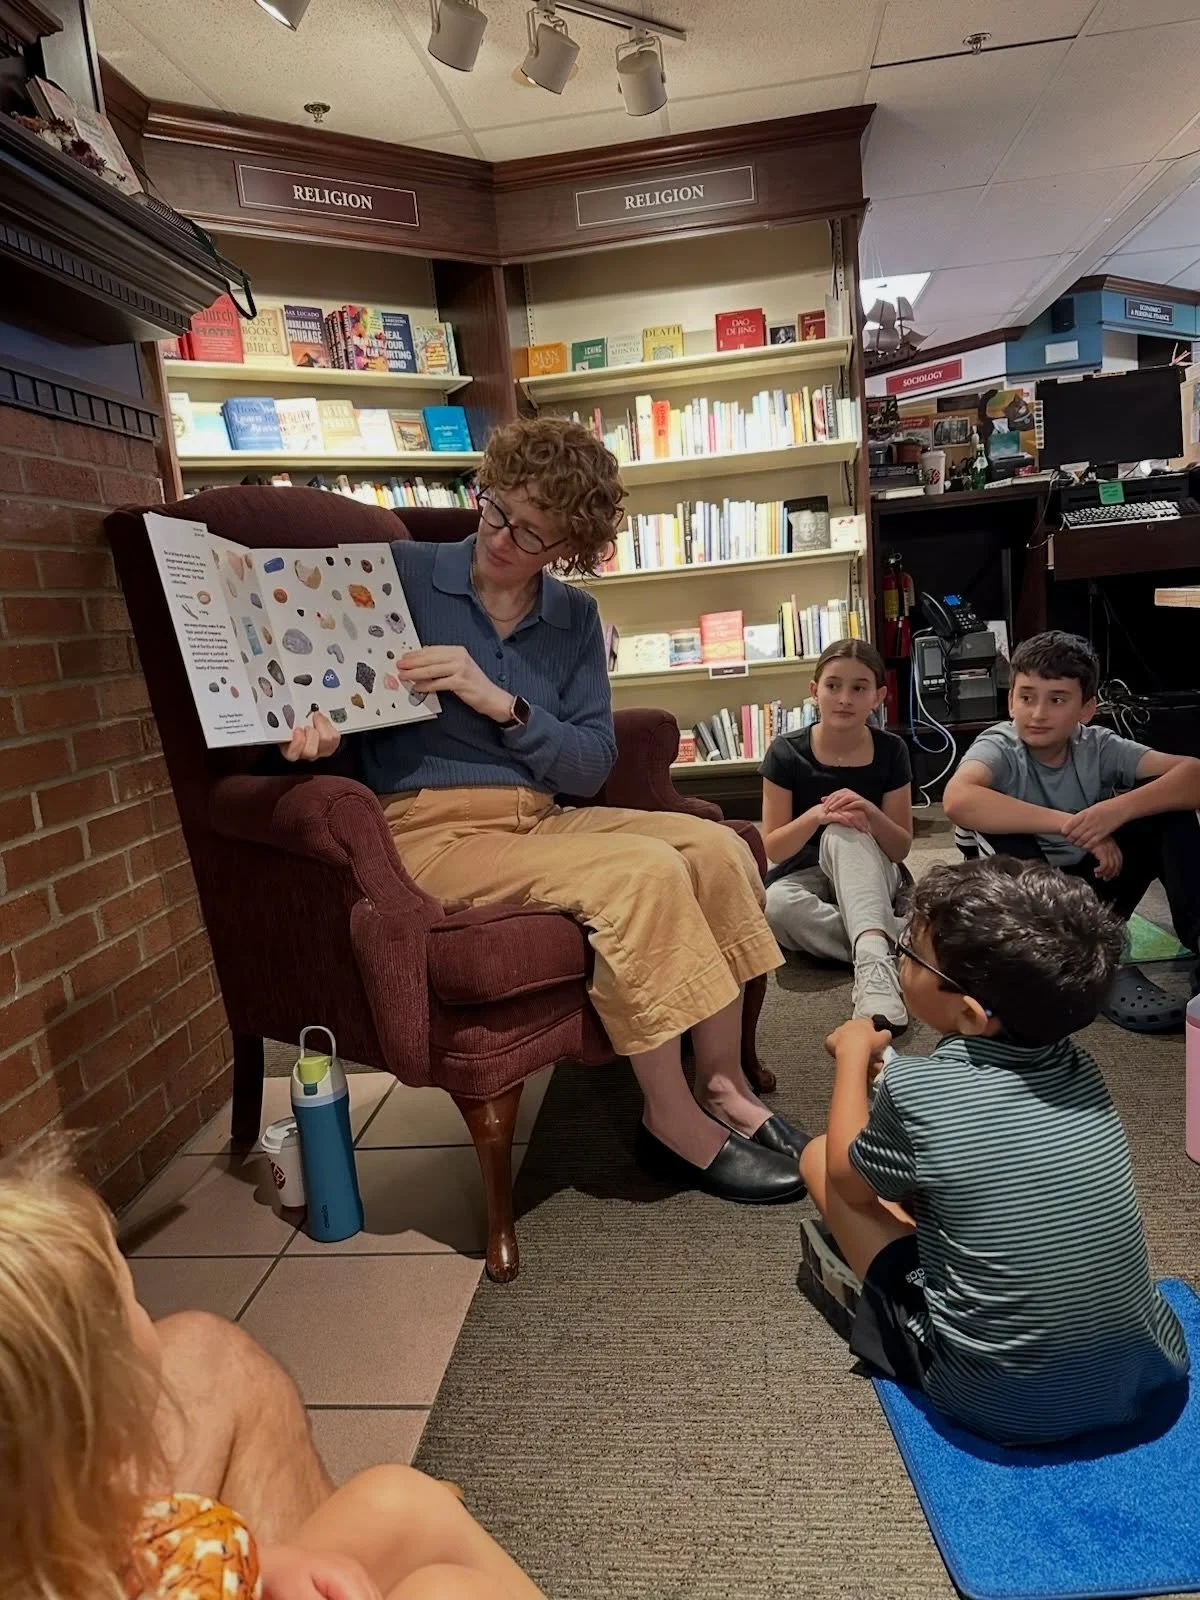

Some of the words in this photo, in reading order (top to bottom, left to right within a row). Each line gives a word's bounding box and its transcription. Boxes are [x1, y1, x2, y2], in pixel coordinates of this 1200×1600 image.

[293, 184, 373, 210] RELIGION
[624, 184, 705, 210] RELIGION
[1140, 304, 1162, 313] ECONOMICS
[247, 316, 273, 327] LOST
[731, 319, 750, 328] DAO
[242, 326, 279, 337] BOOKS
[288, 329, 323, 344] COURAGE
[645, 326, 681, 338] DEATH
[737, 325, 757, 336] JING
[246, 341, 280, 353] BIBLE
[903, 370, 943, 387] SOCIOLOGY
